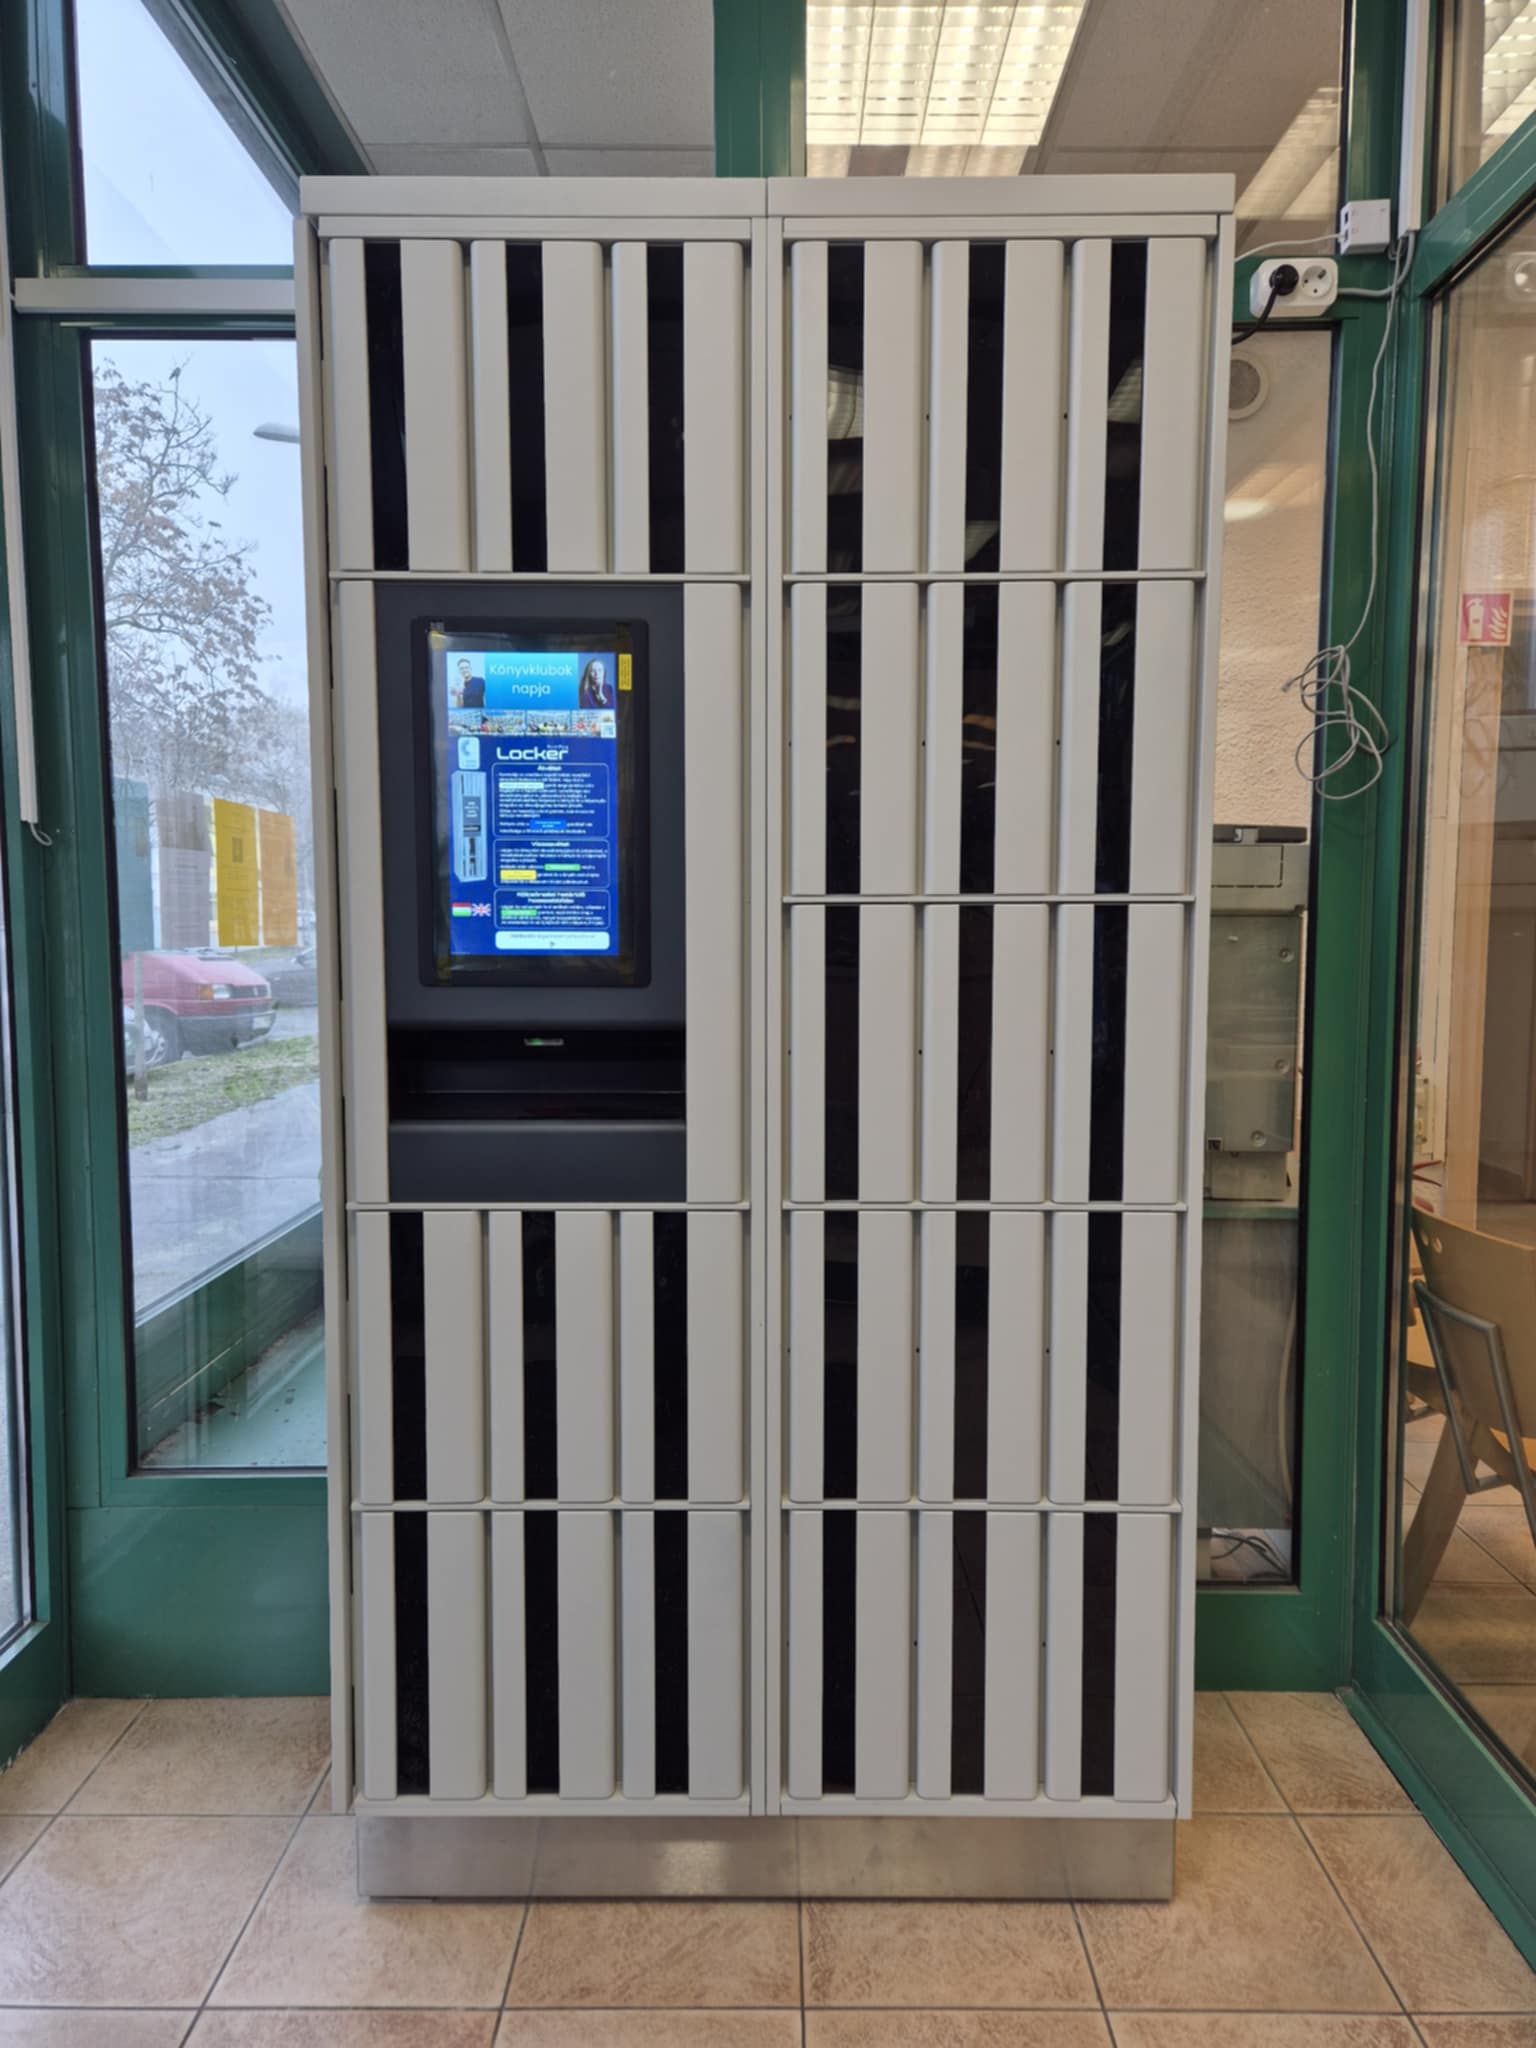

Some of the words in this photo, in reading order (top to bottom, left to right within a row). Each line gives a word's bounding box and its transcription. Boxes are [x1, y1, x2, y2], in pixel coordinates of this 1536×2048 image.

[489, 663, 573, 679] Könyvklubok
[511, 682, 551, 698] napja
[496, 746, 568, 761] Locker
